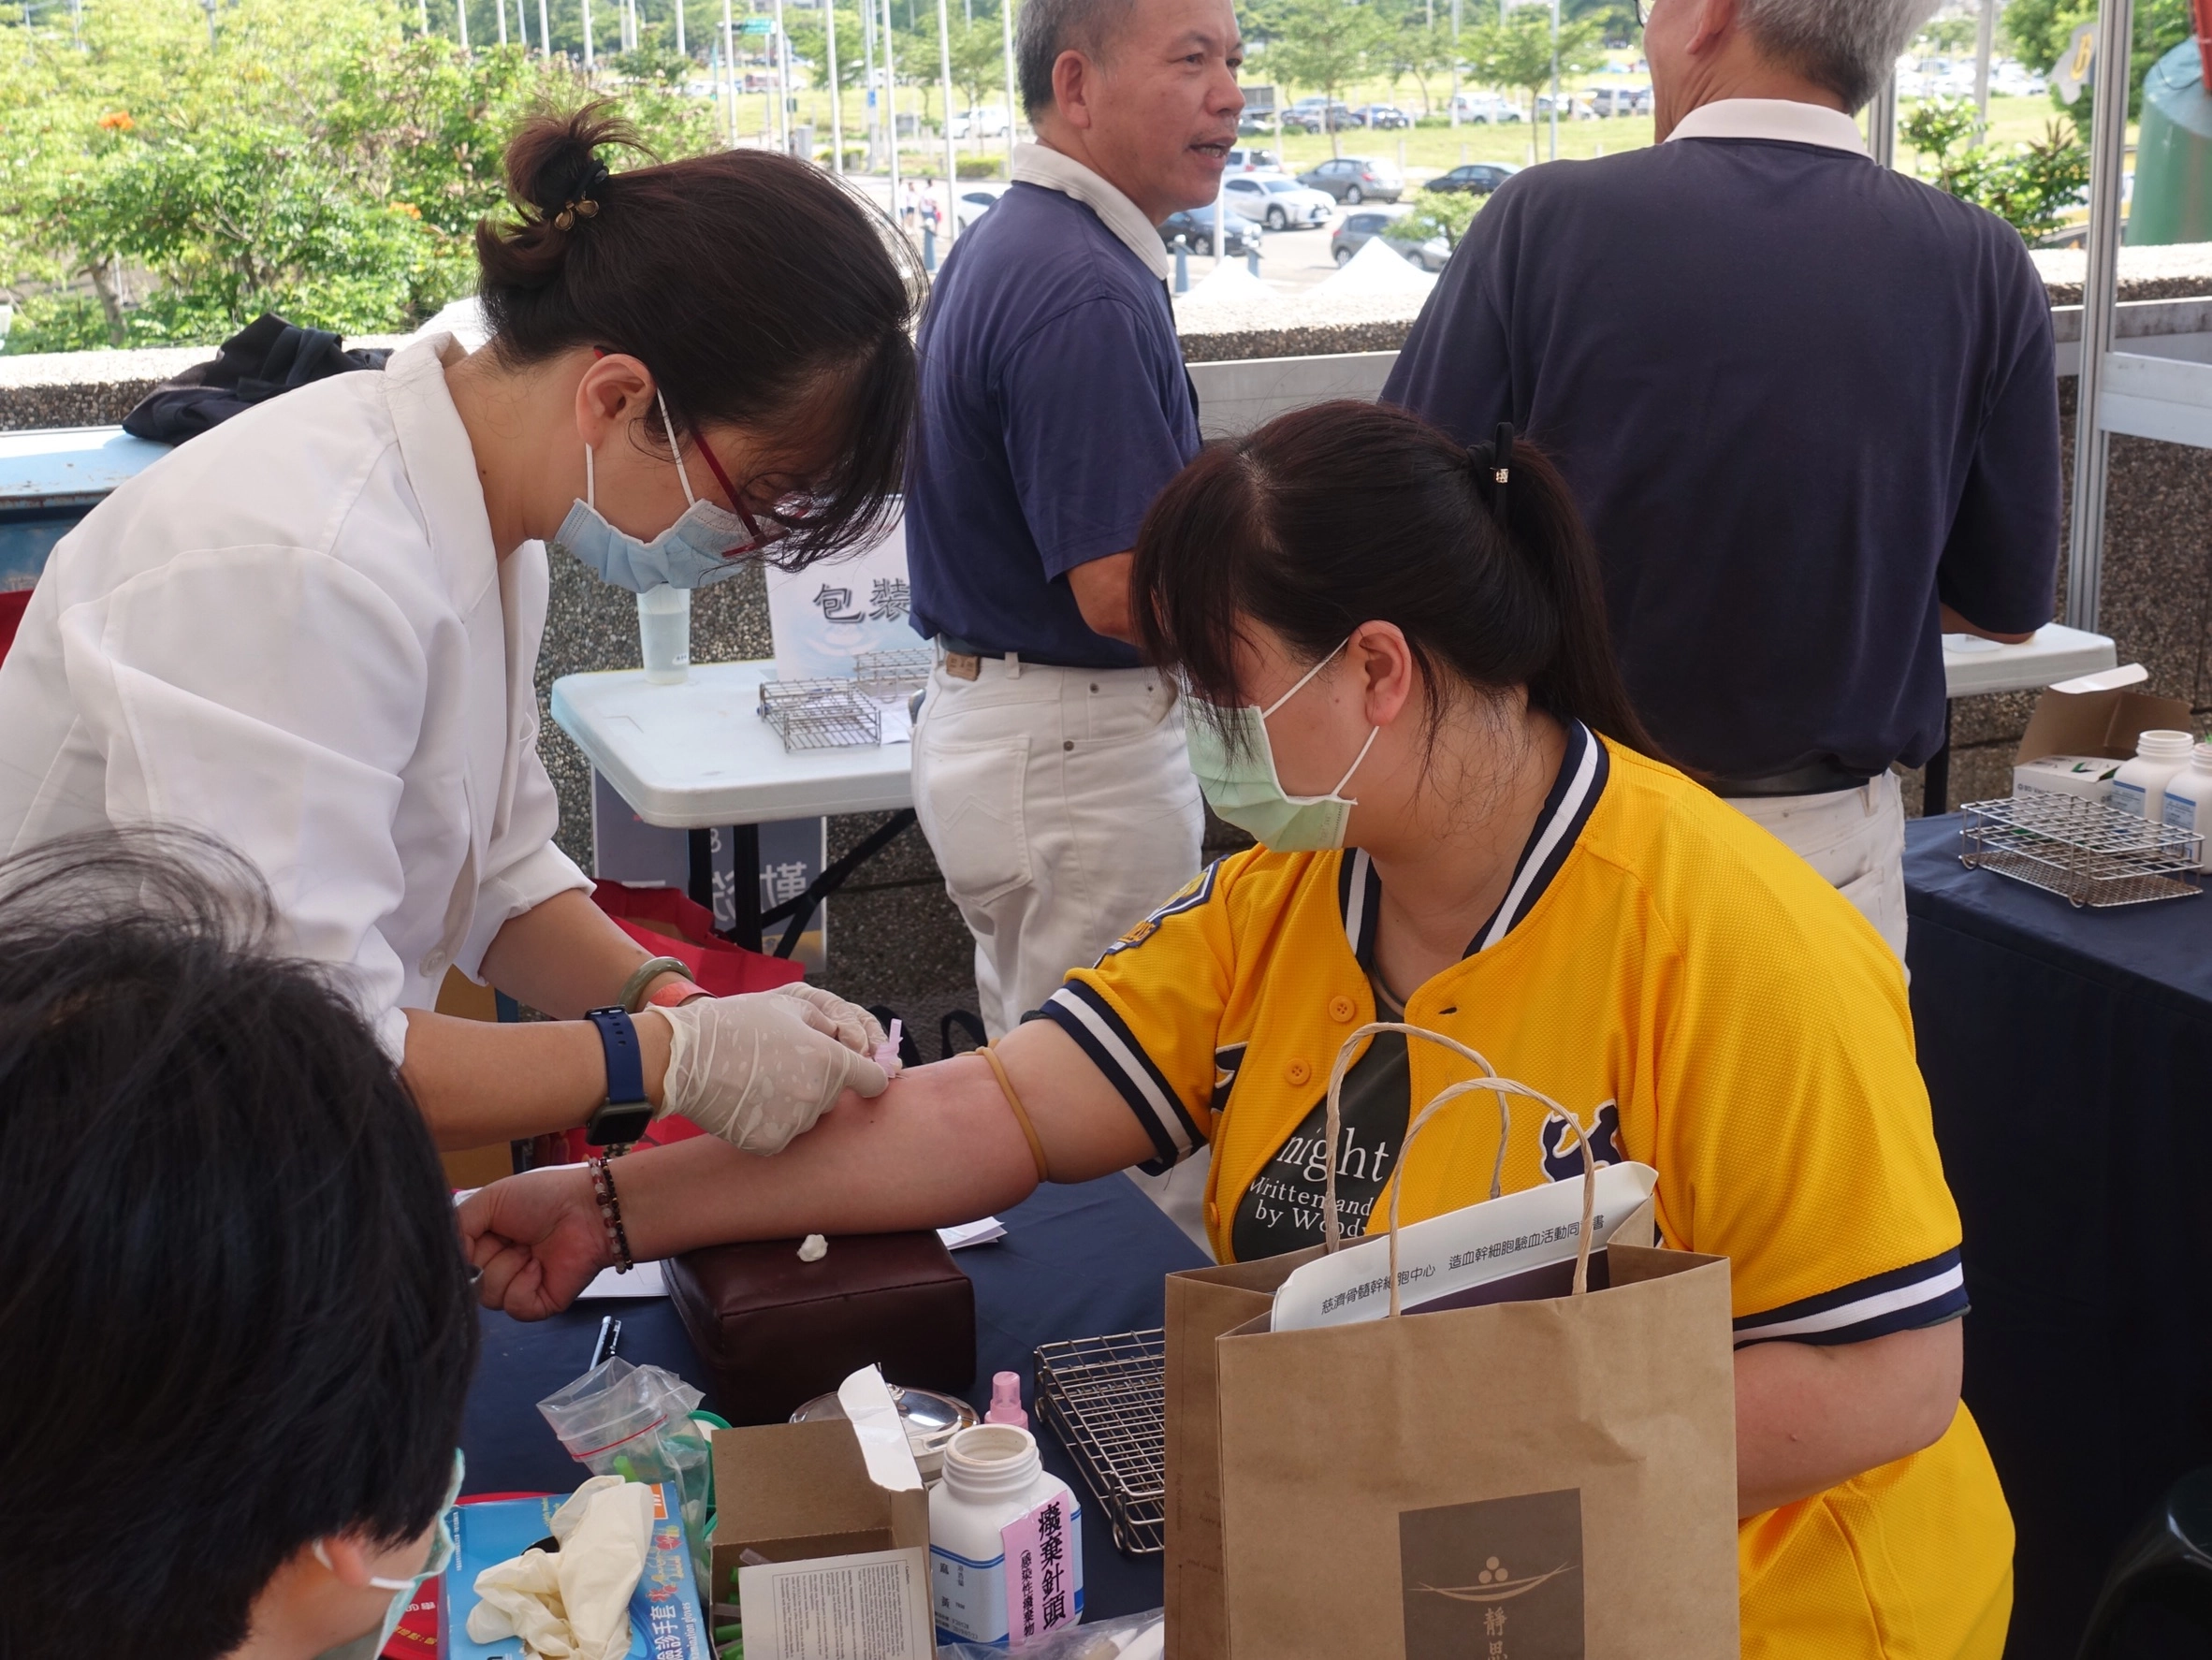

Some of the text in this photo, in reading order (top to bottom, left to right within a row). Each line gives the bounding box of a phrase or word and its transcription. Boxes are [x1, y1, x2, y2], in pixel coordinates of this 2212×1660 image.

[812, 577, 910, 623] 包裝
[1276, 1127, 1390, 1183] night
[1249, 1176, 1375, 1216] Written and
[1255, 1199, 1284, 1228] by
[1448, 1215, 1605, 1271] 造血幹細胞驗血活動同書
[681, 1602, 696, 1623] gloves
